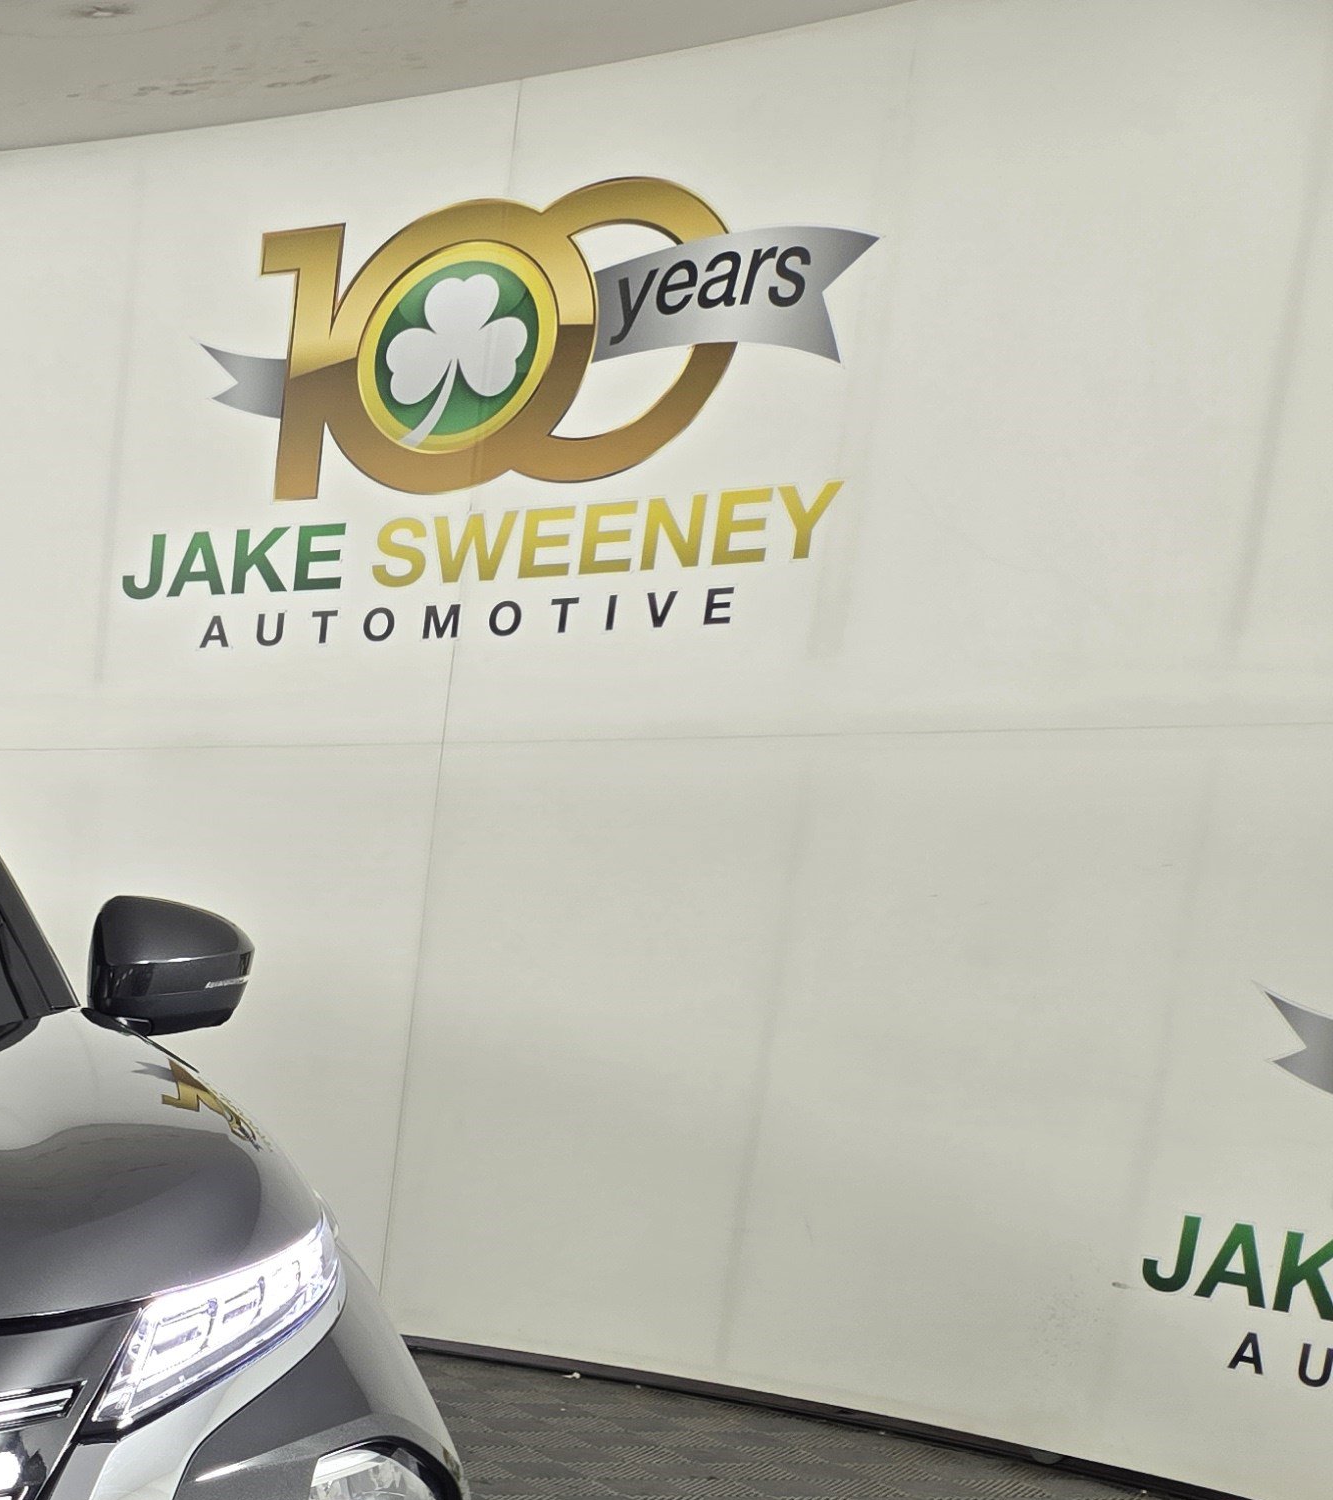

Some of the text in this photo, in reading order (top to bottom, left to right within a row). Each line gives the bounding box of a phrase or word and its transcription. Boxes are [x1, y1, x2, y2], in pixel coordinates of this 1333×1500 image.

[259, 175, 812, 501] 100 years
[122, 480, 845, 600] JAKE SWEENEY
[199, 586, 735, 649] AUTOMOTIVE
[1142, 1215, 1333, 1322] JAK
[1227, 1332, 1333, 1388] AU
